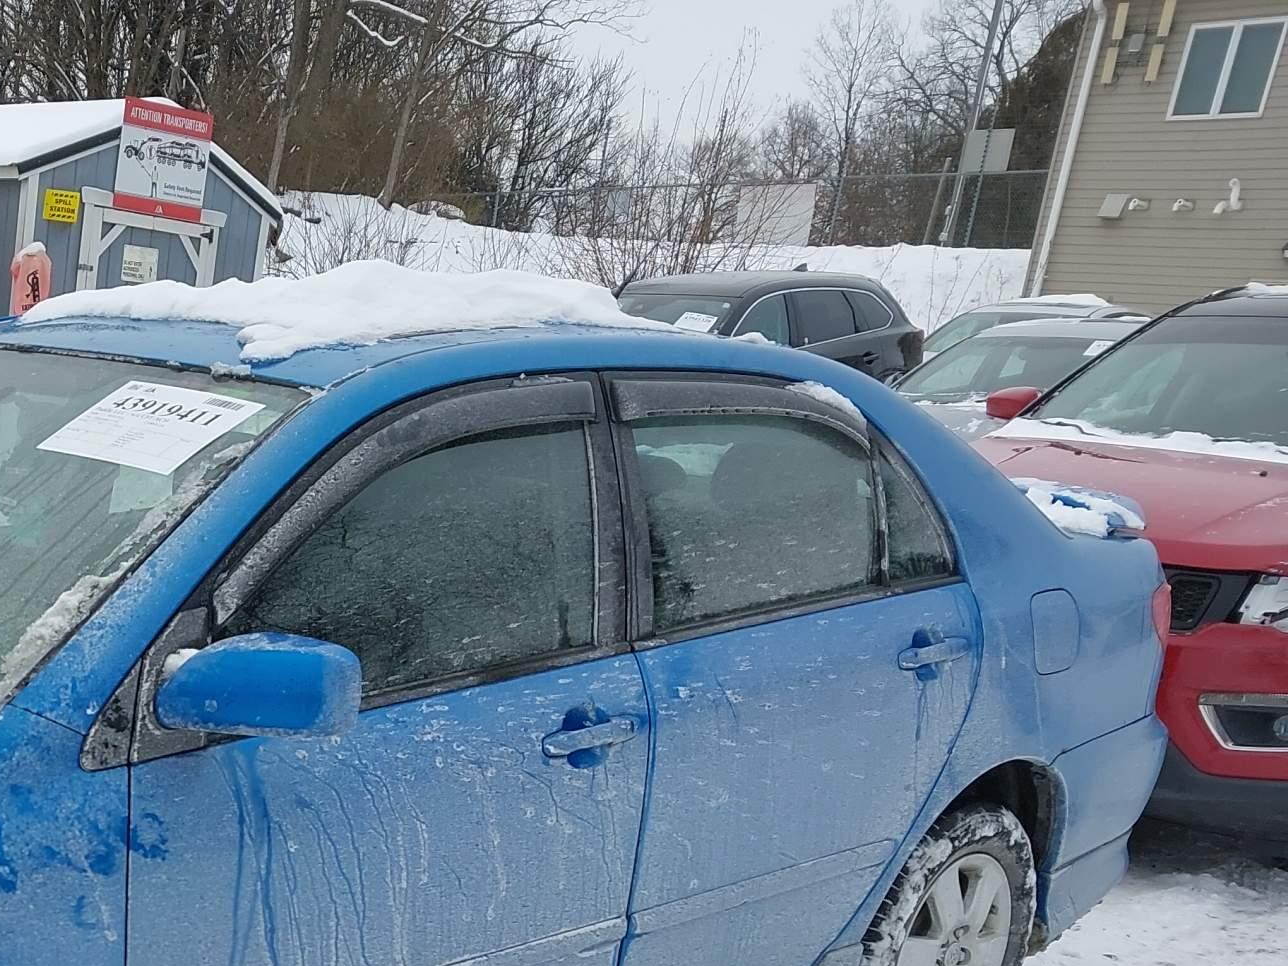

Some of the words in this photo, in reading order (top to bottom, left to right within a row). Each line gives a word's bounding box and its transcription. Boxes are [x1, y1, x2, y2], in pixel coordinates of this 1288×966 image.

[130, 107, 162, 124] ATTENTION
[163, 113, 208, 134] TRANSPORTERS!
[49, 206, 76, 214] STATION
[55, 198, 72, 206] SPILL
[112, 396, 223, 426] 43919411
